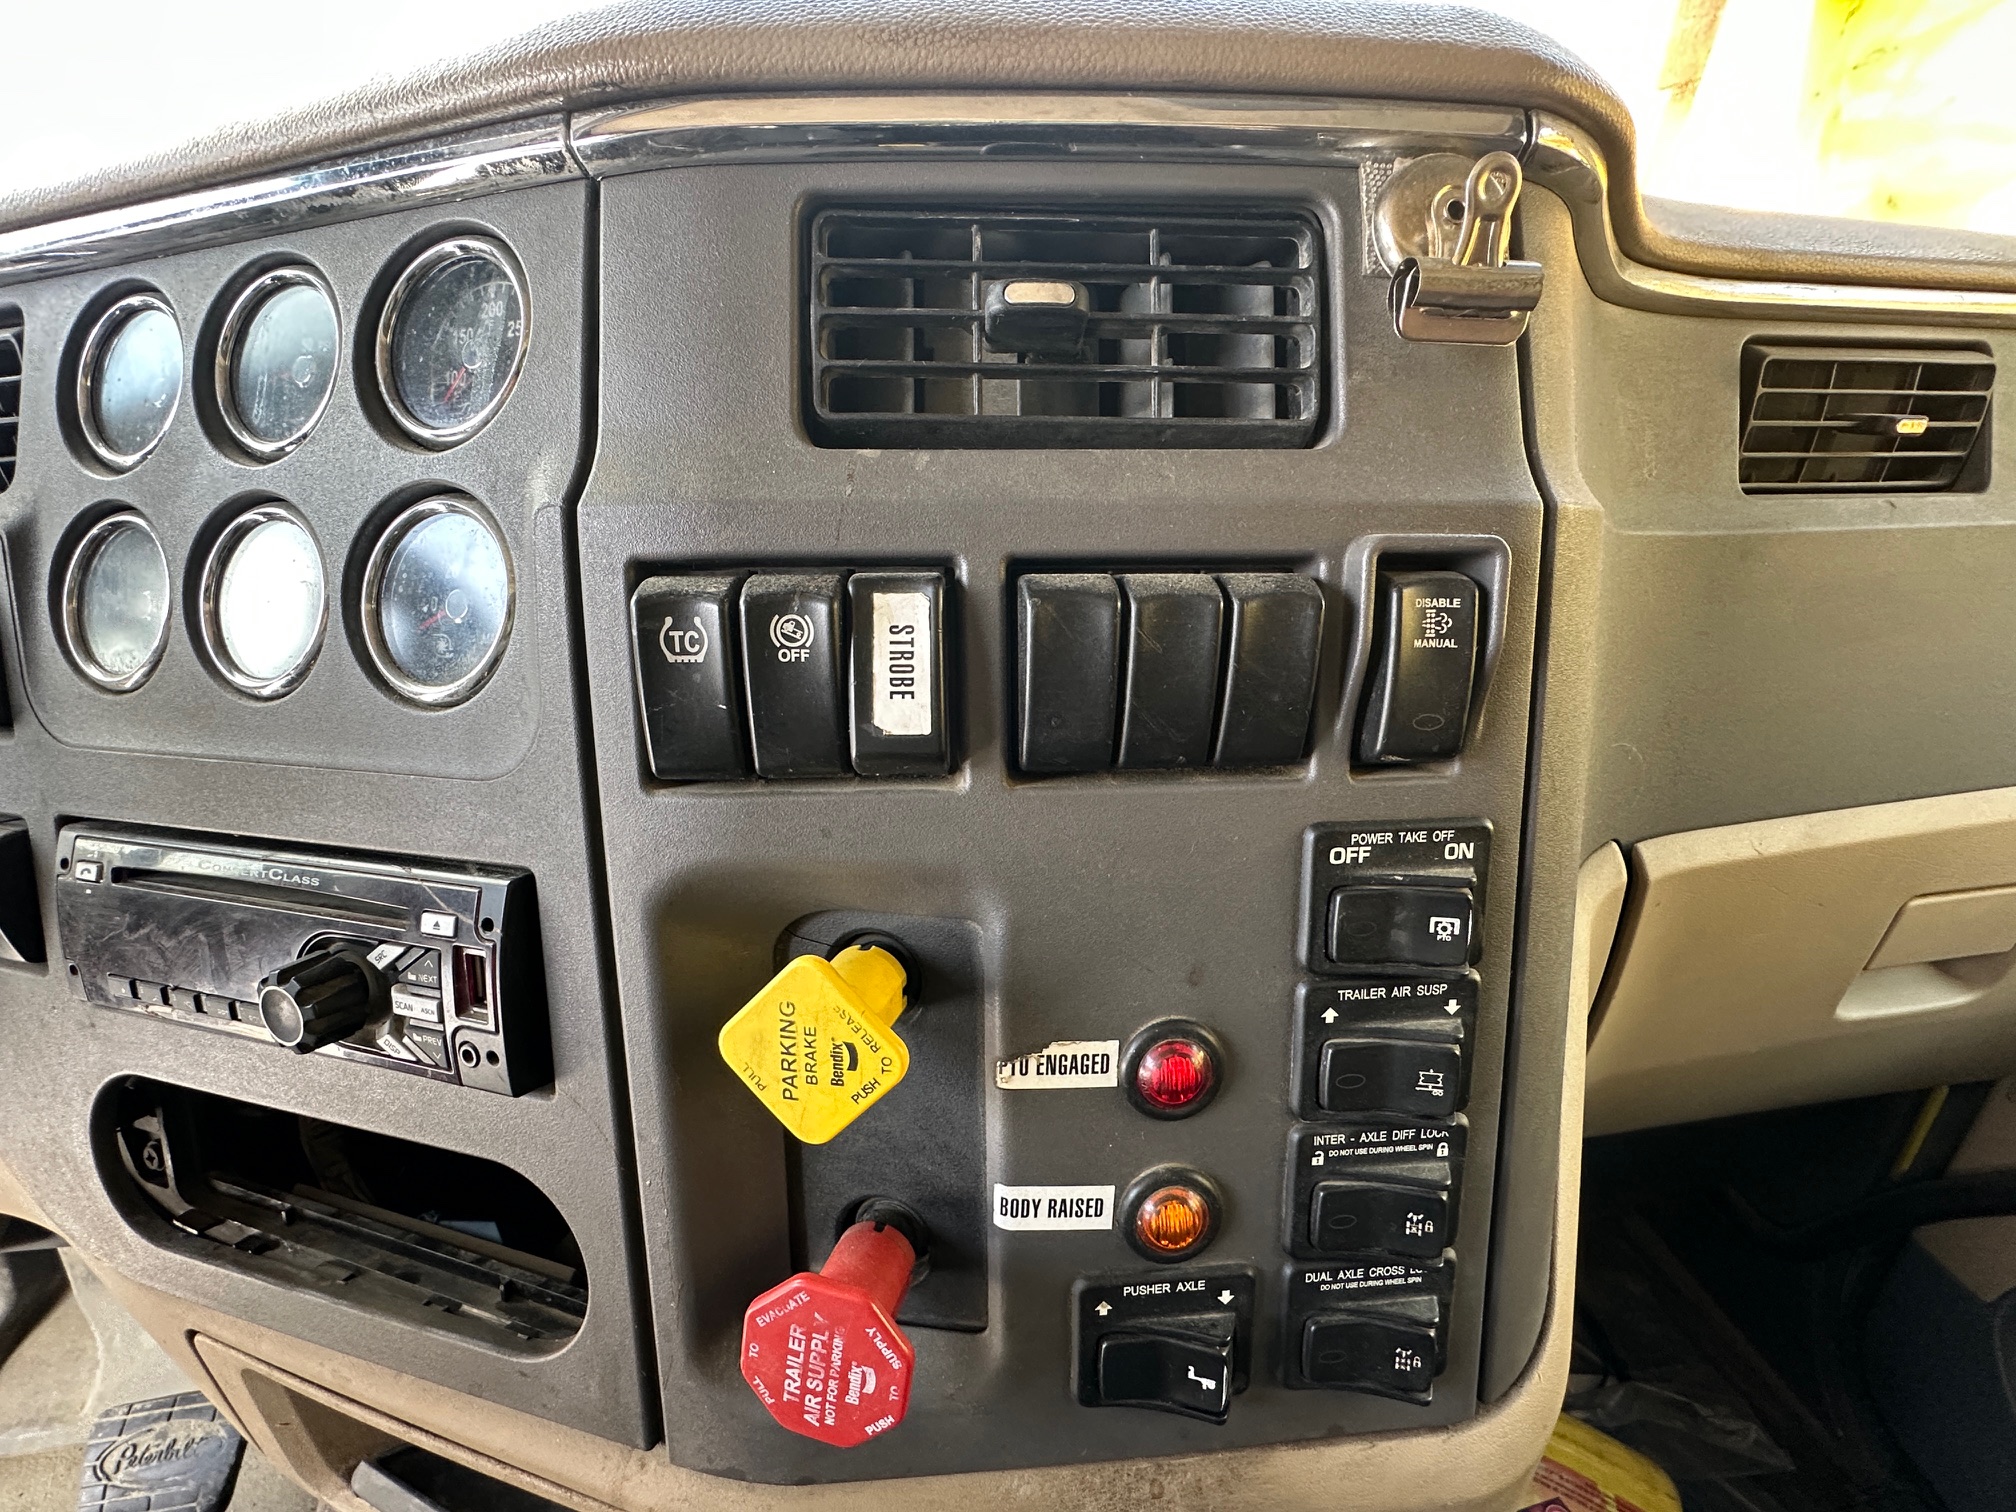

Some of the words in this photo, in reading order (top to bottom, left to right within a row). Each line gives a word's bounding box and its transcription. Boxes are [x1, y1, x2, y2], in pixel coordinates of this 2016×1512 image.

[507, 320, 522, 338] 25
[1415, 598, 1461, 608] DISABLE
[668, 631, 700, 653] TC
[1413, 638, 1458, 648] MANUAL
[777, 649, 810, 663] OFF
[889, 624, 915, 700] STROBE
[1351, 832, 1393, 845] POWER
[1398, 831, 1427, 844] TAKE
[1432, 830, 1455, 842] OFF
[1329, 846, 1372, 865] OFF
[1444, 842, 1474, 860] ON
[418, 974, 438, 983] NEXT
[1337, 987, 1386, 1001] TRAILER
[1391, 986, 1411, 999] AIR
[1416, 984, 1448, 997] SUSP
[394, 1001, 414, 1012] SCAN
[422, 1035, 442, 1047] PREV
[779, 1000, 800, 1102] PARKING
[803, 1026, 818, 1085] BRAKE
[1036, 1053, 1110, 1076] ENGAGED
[742, 1061, 767, 1092] PULL
[851, 1077, 881, 1105] PUSH
[881, 1056, 893, 1075] TO
[1313, 1134, 1346, 1146] INTER
[1359, 1131, 1387, 1143] AXLE
[1392, 1129, 1416, 1141] DIFF
[1340, 1148, 1354, 1156] NOT
[1354, 1147, 1368, 1155] USE
[1369, 1145, 1394, 1154] DURING
[1395, 1144, 1417, 1152] WHEEL
[1418, 1143, 1434, 1151] SPIN
[999, 1197, 1042, 1218] BODY
[1047, 1198, 1104, 1218] RAISED
[1305, 1271, 1333, 1283] DUAL
[1337, 1268, 1365, 1280] AXLE
[1368, 1265, 1405, 1278] CROSS
[1331, 1282, 1344, 1290] NOT
[1359, 1279, 1383, 1288] DURING
[1384, 1277, 1406, 1285] WHEEL
[1406, 1276, 1422, 1284] SPIN
[1123, 1283, 1171, 1297] PUSHER
[1176, 1280, 1206, 1292] AXLE
[748, 1343, 760, 1359] TO
[864, 1327, 903, 1370] SUPPLY
[783, 1323, 807, 1402] TRAILER
[752, 1376, 776, 1405] PULL
[826, 1378, 839, 1402] FOR
[803, 1394, 822, 1427] AIR
[824, 1401, 837, 1426] NOT
[864, 1414, 895, 1436] PUSH
